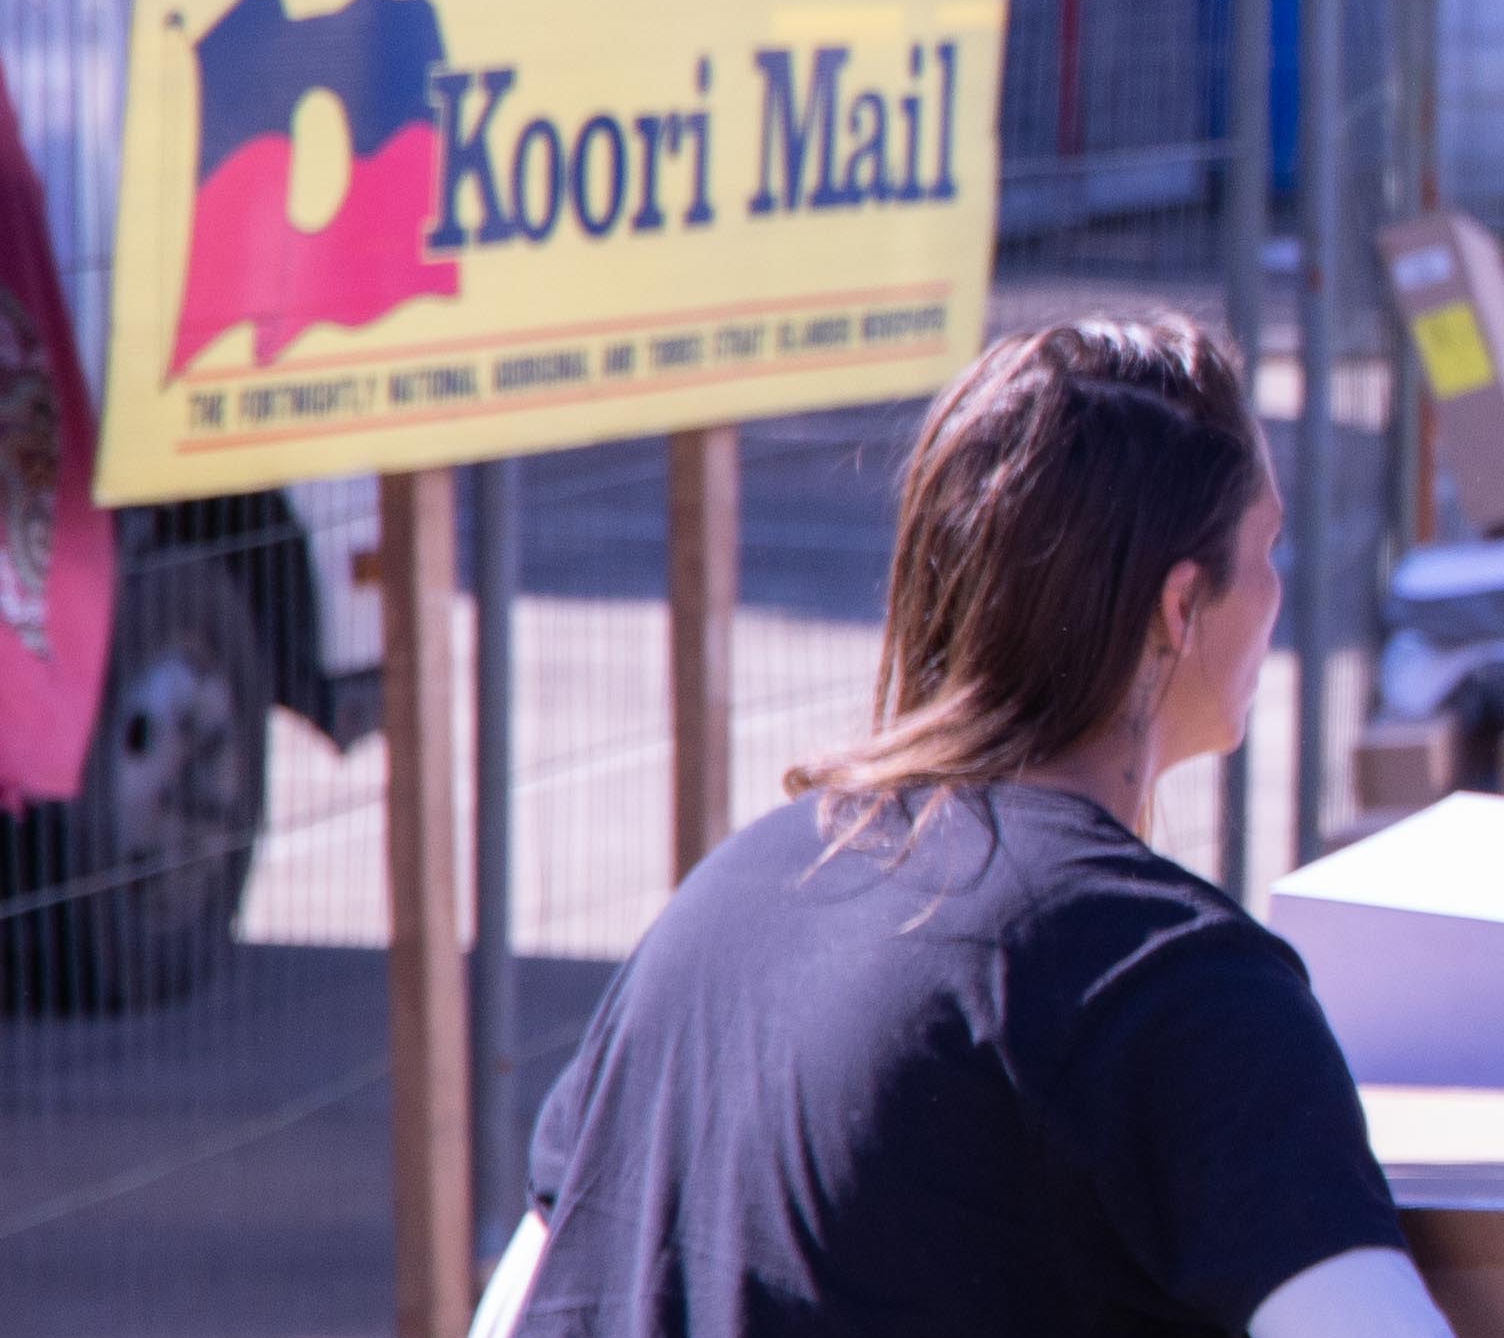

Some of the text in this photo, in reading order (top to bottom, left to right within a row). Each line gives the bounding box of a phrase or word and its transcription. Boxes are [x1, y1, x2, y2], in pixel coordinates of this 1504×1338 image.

[425, 42, 958, 257] Koori Mail
[189, 393, 224, 429] THE
[389, 365, 477, 405] NATIONAL
[603, 344, 635, 375] AND
